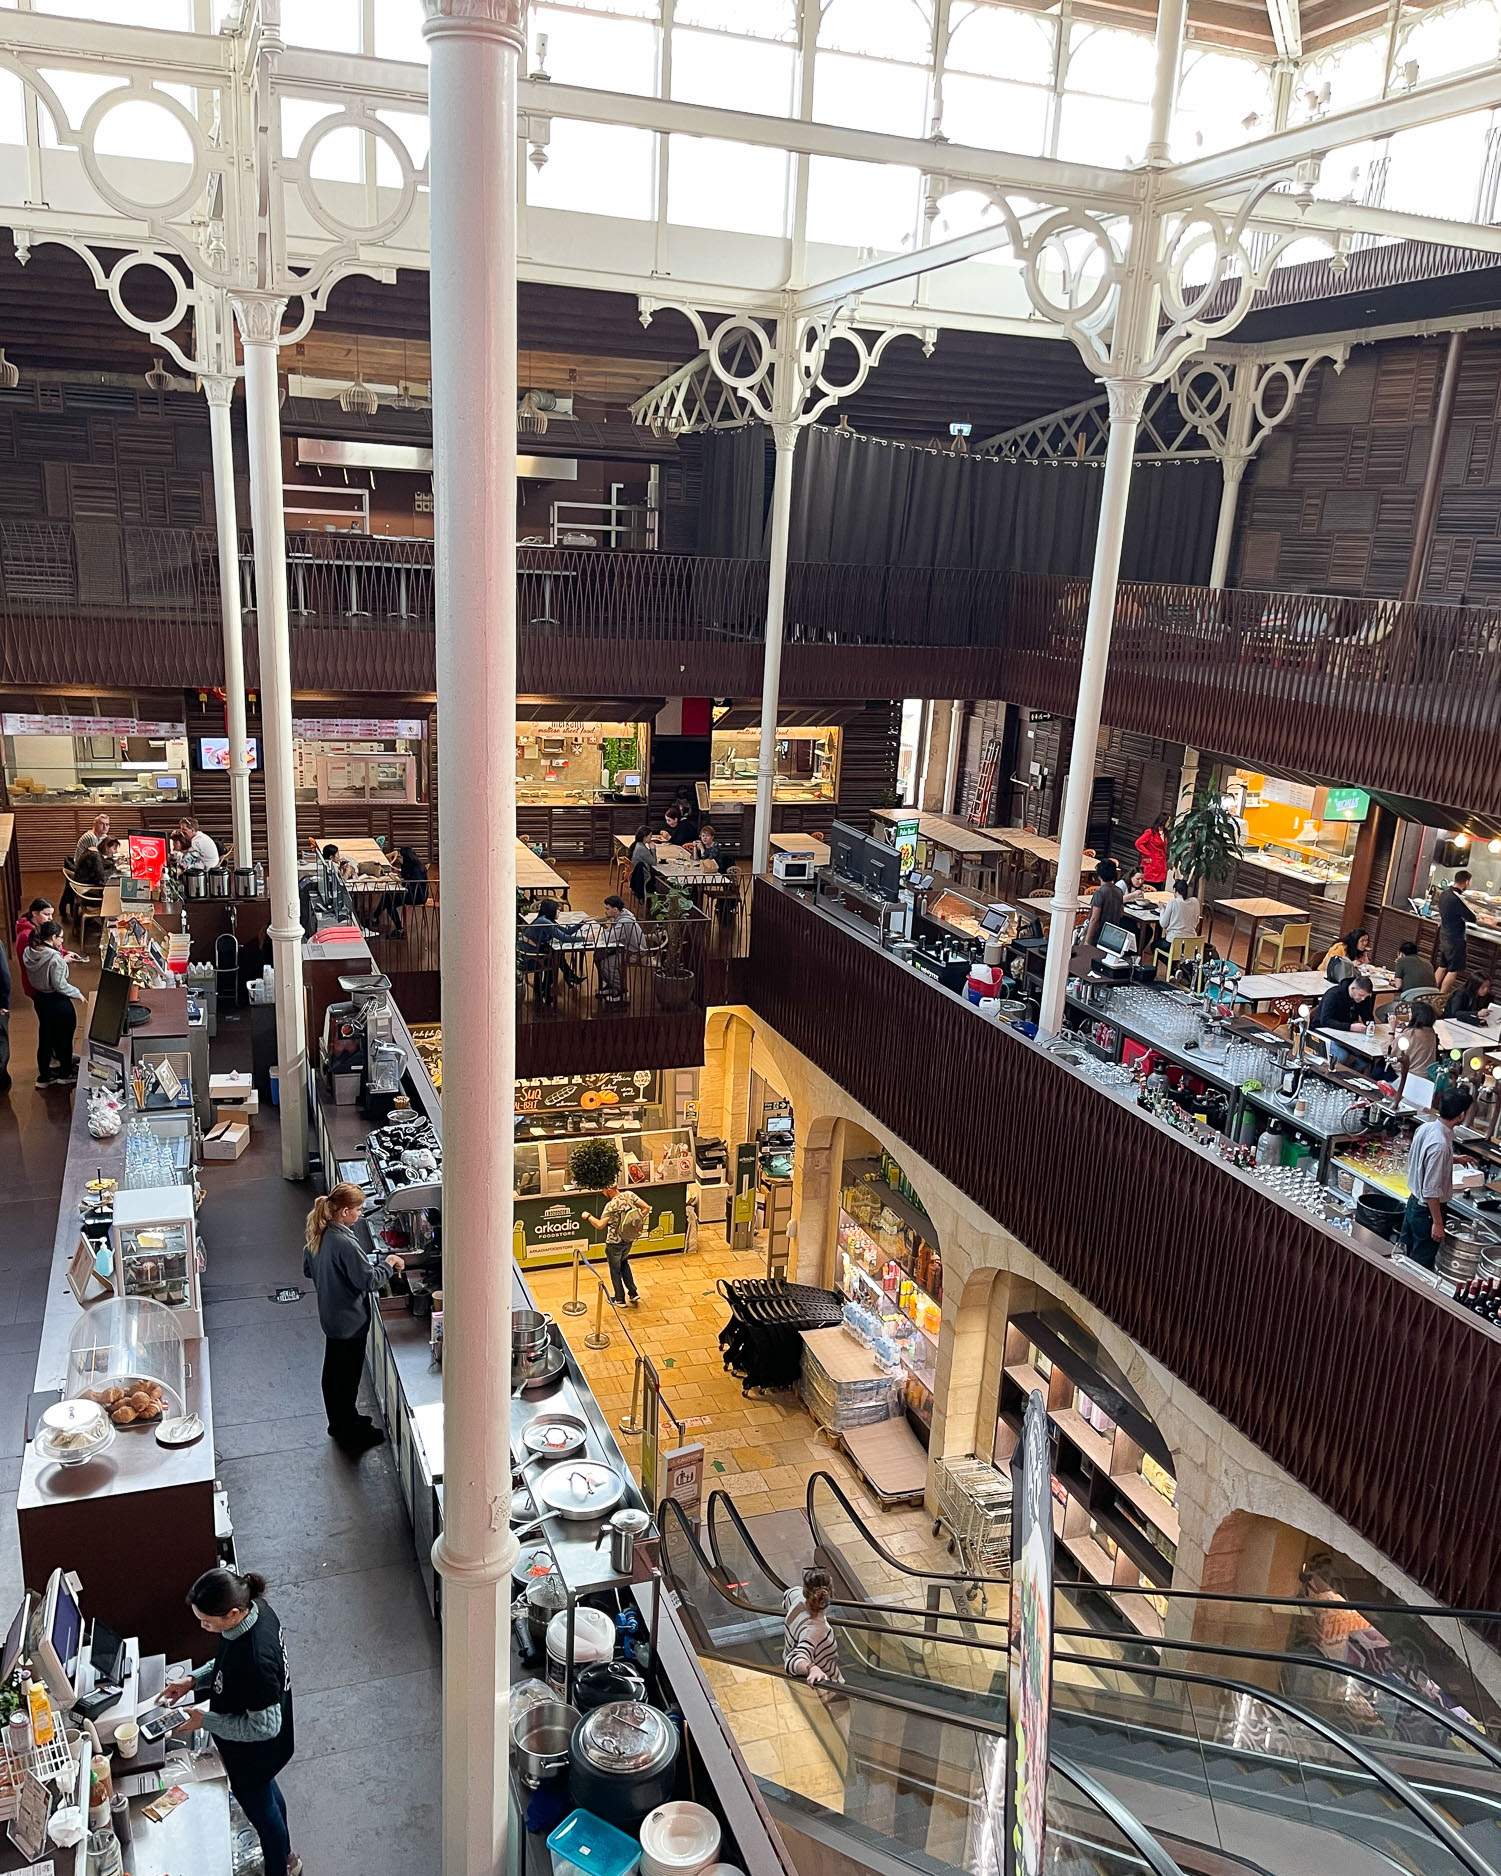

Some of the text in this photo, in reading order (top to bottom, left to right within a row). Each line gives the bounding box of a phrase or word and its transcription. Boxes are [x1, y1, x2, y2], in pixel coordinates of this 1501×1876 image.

[580, 726, 596, 735] food
[534, 1219, 580, 1234] arkadia
[538, 1231, 576, 1239] FOODSTORE
